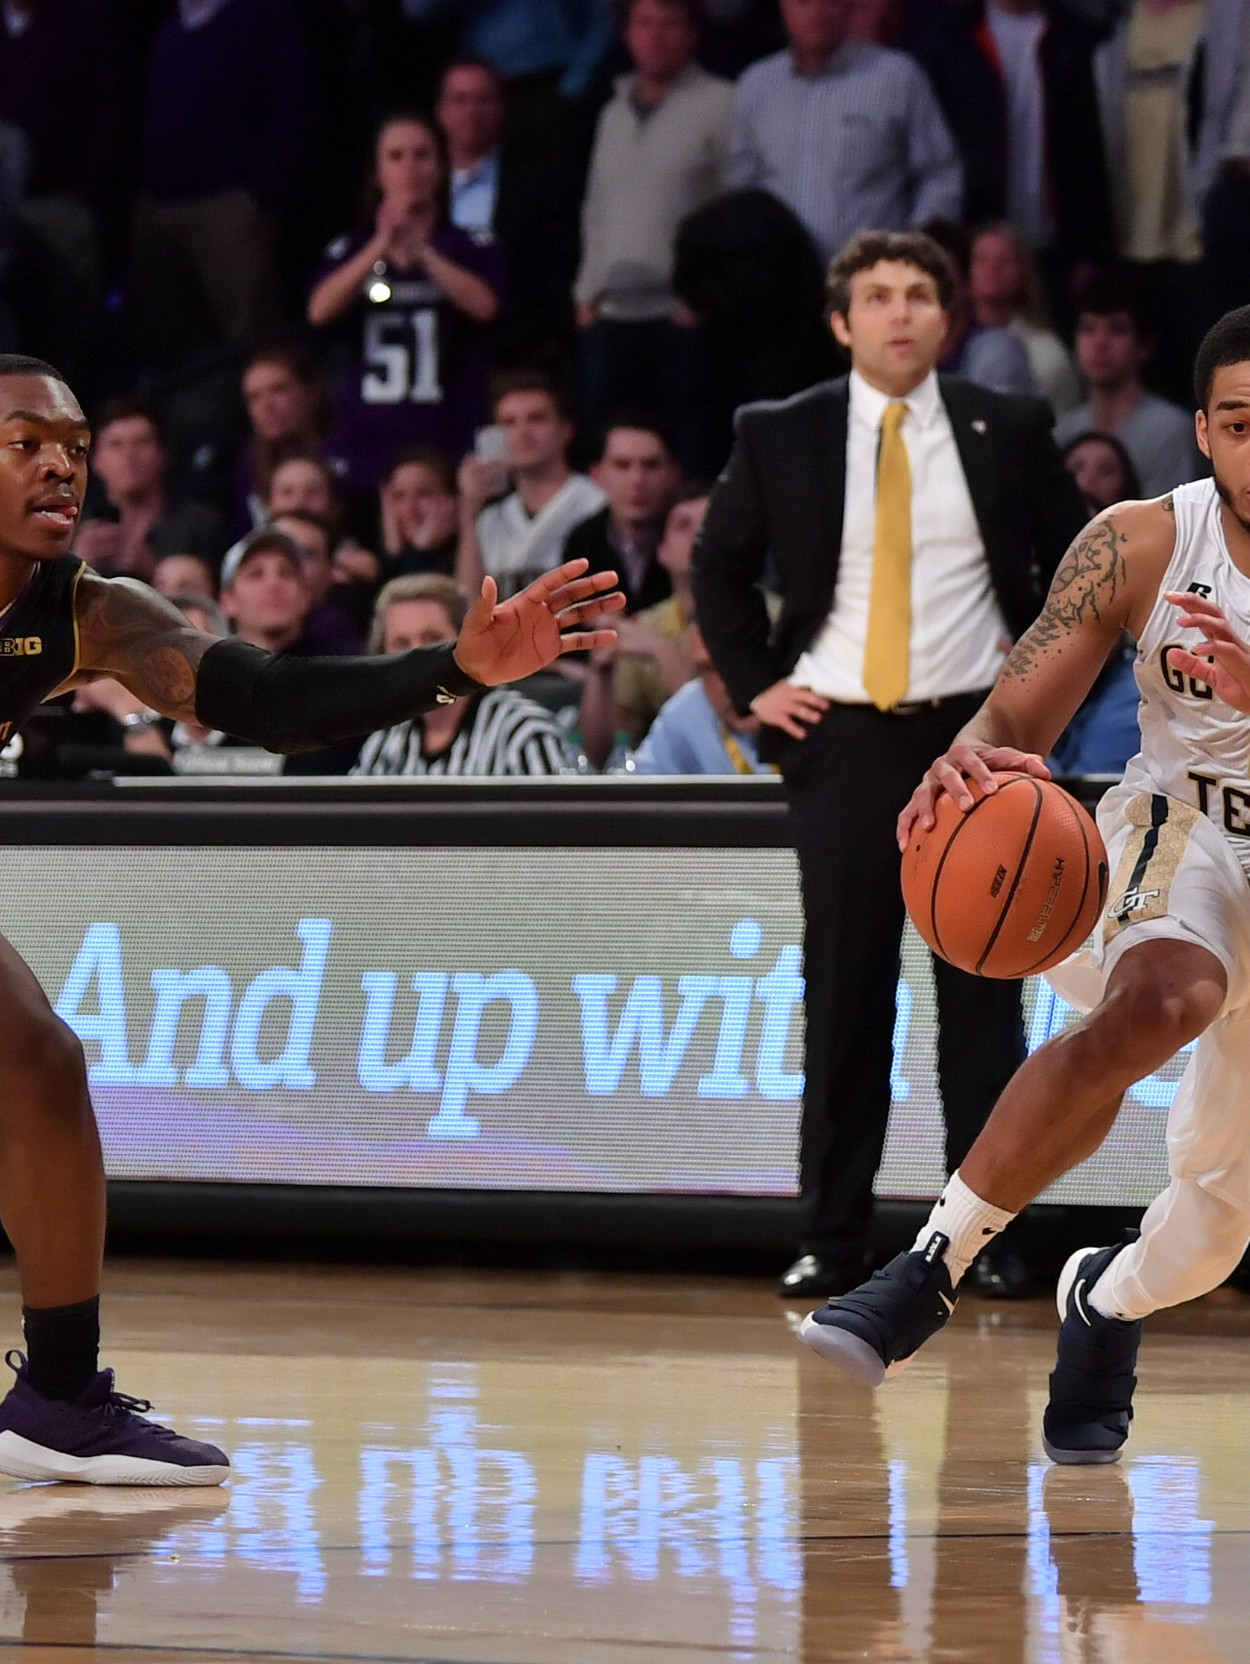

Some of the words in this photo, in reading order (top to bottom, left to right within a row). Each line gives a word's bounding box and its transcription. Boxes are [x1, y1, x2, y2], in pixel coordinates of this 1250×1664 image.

[361, 311, 442, 404] 51
[53, 917, 334, 1091] And
[357, 970, 539, 1138] up
[571, 917, 913, 1102] wit
